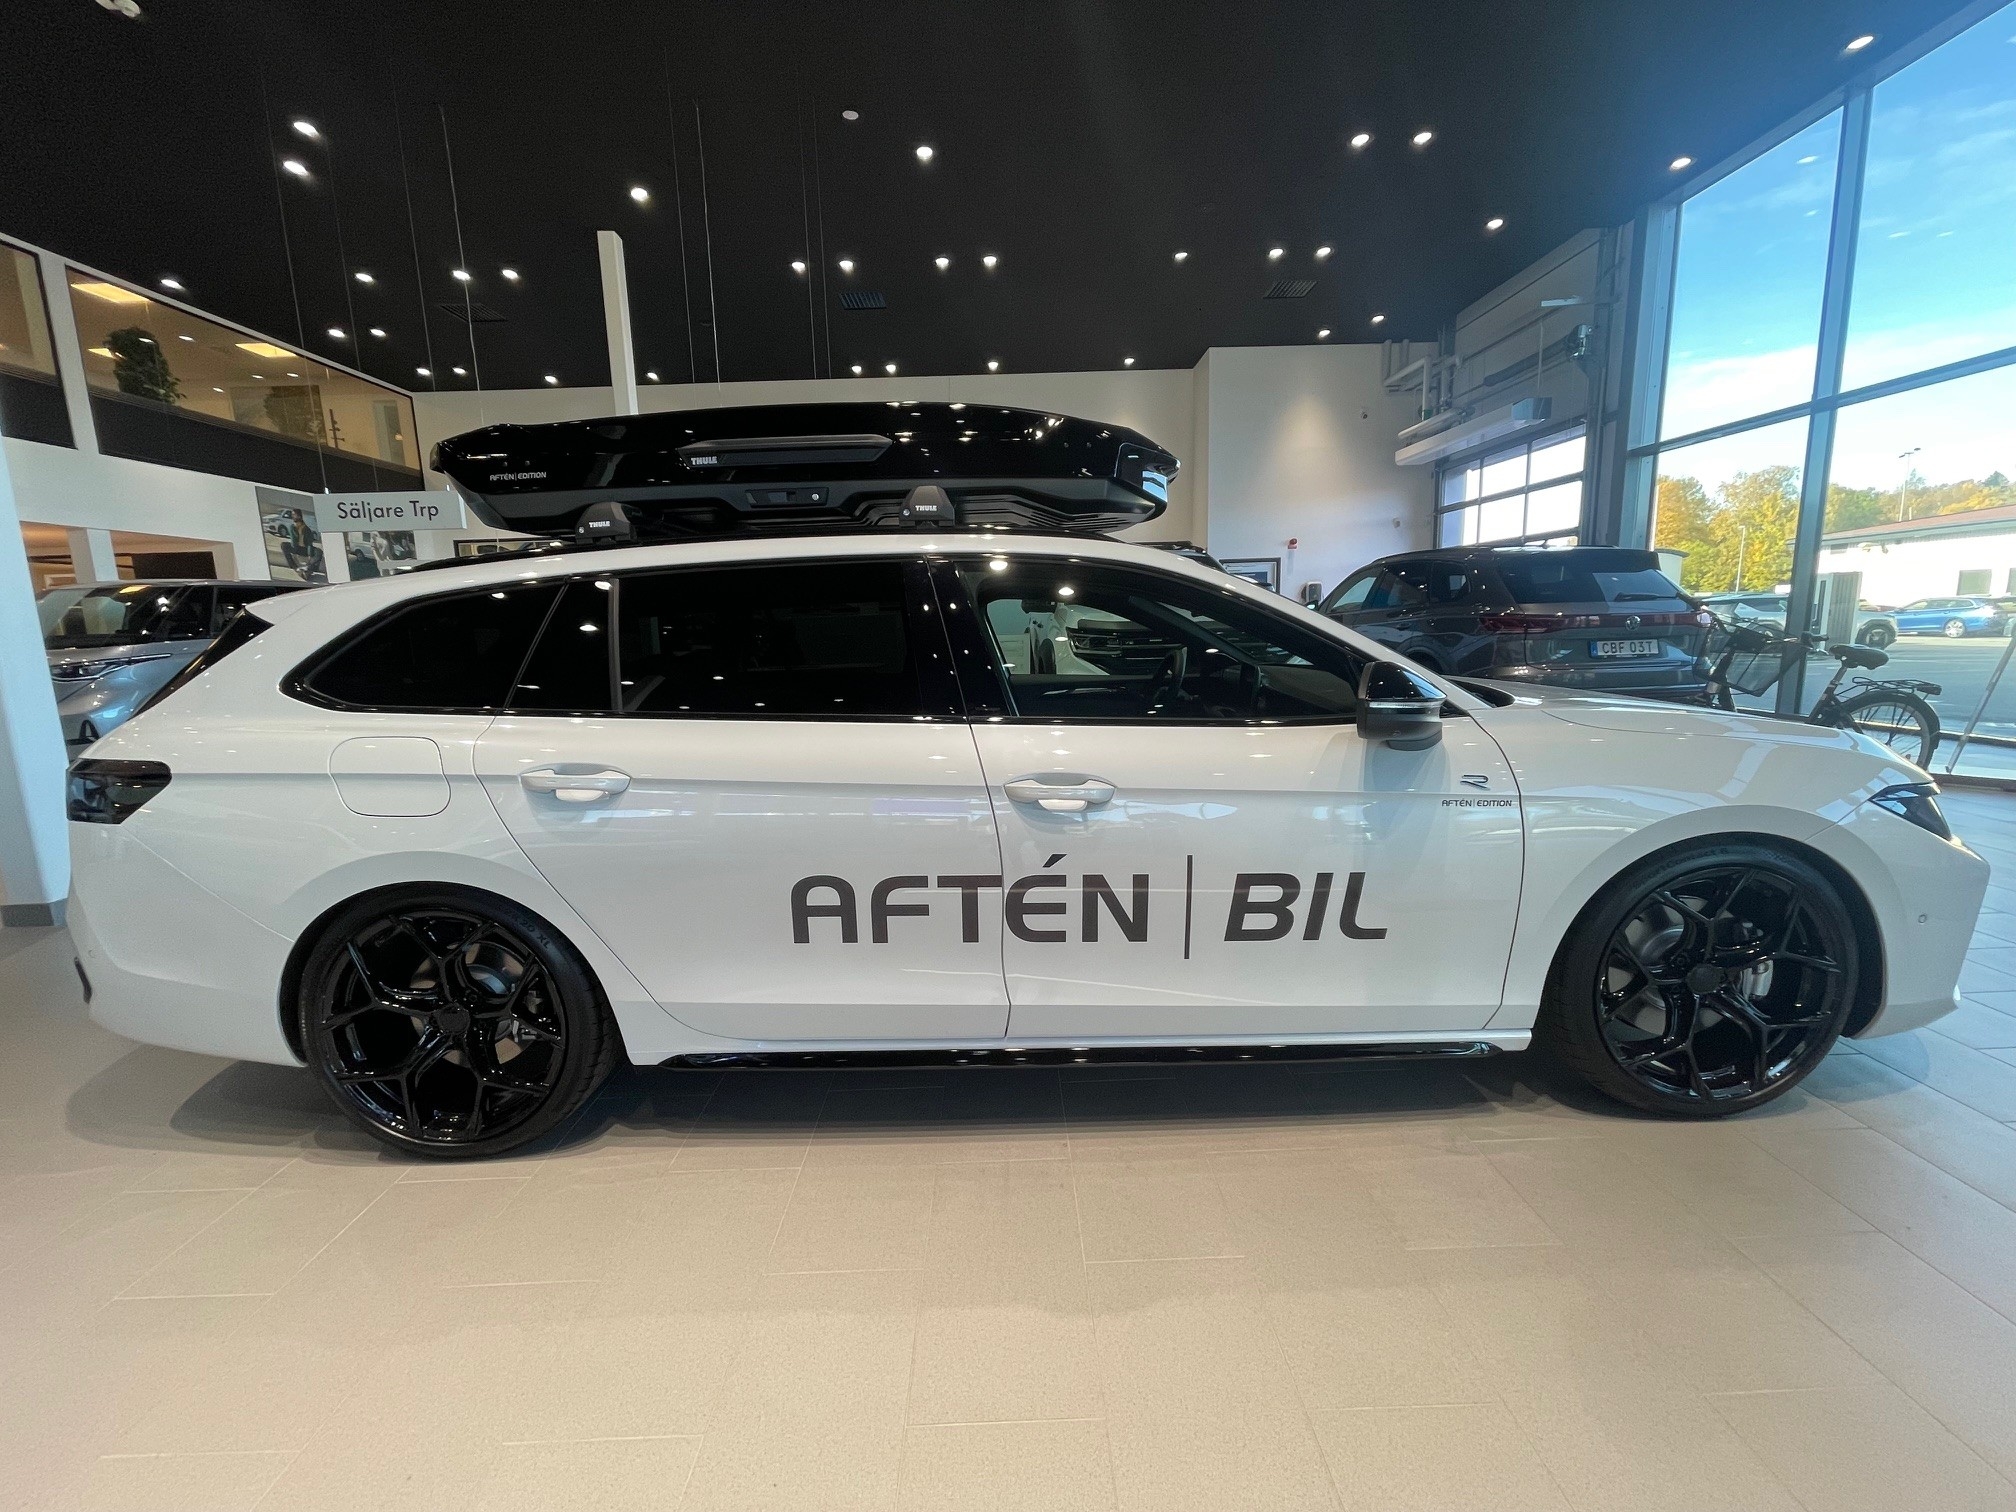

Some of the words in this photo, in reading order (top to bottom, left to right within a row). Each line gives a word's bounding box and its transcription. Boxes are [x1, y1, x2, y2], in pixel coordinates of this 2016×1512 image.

[690, 456, 718, 466] THULE
[517, 471, 547, 480] EDITION
[337, 501, 404, 523] Säljare
[408, 500, 439, 521] Trp
[915, 504, 938, 513] THULE
[588, 519, 611, 529] THULE
[1602, 641, 1625, 654] CBF
[1629, 641, 1653, 653] 03T
[1476, 799, 1513, 807] EDITION
[790, 853, 1149, 944] AFTÉN
[1223, 871, 1388, 941] BIL
